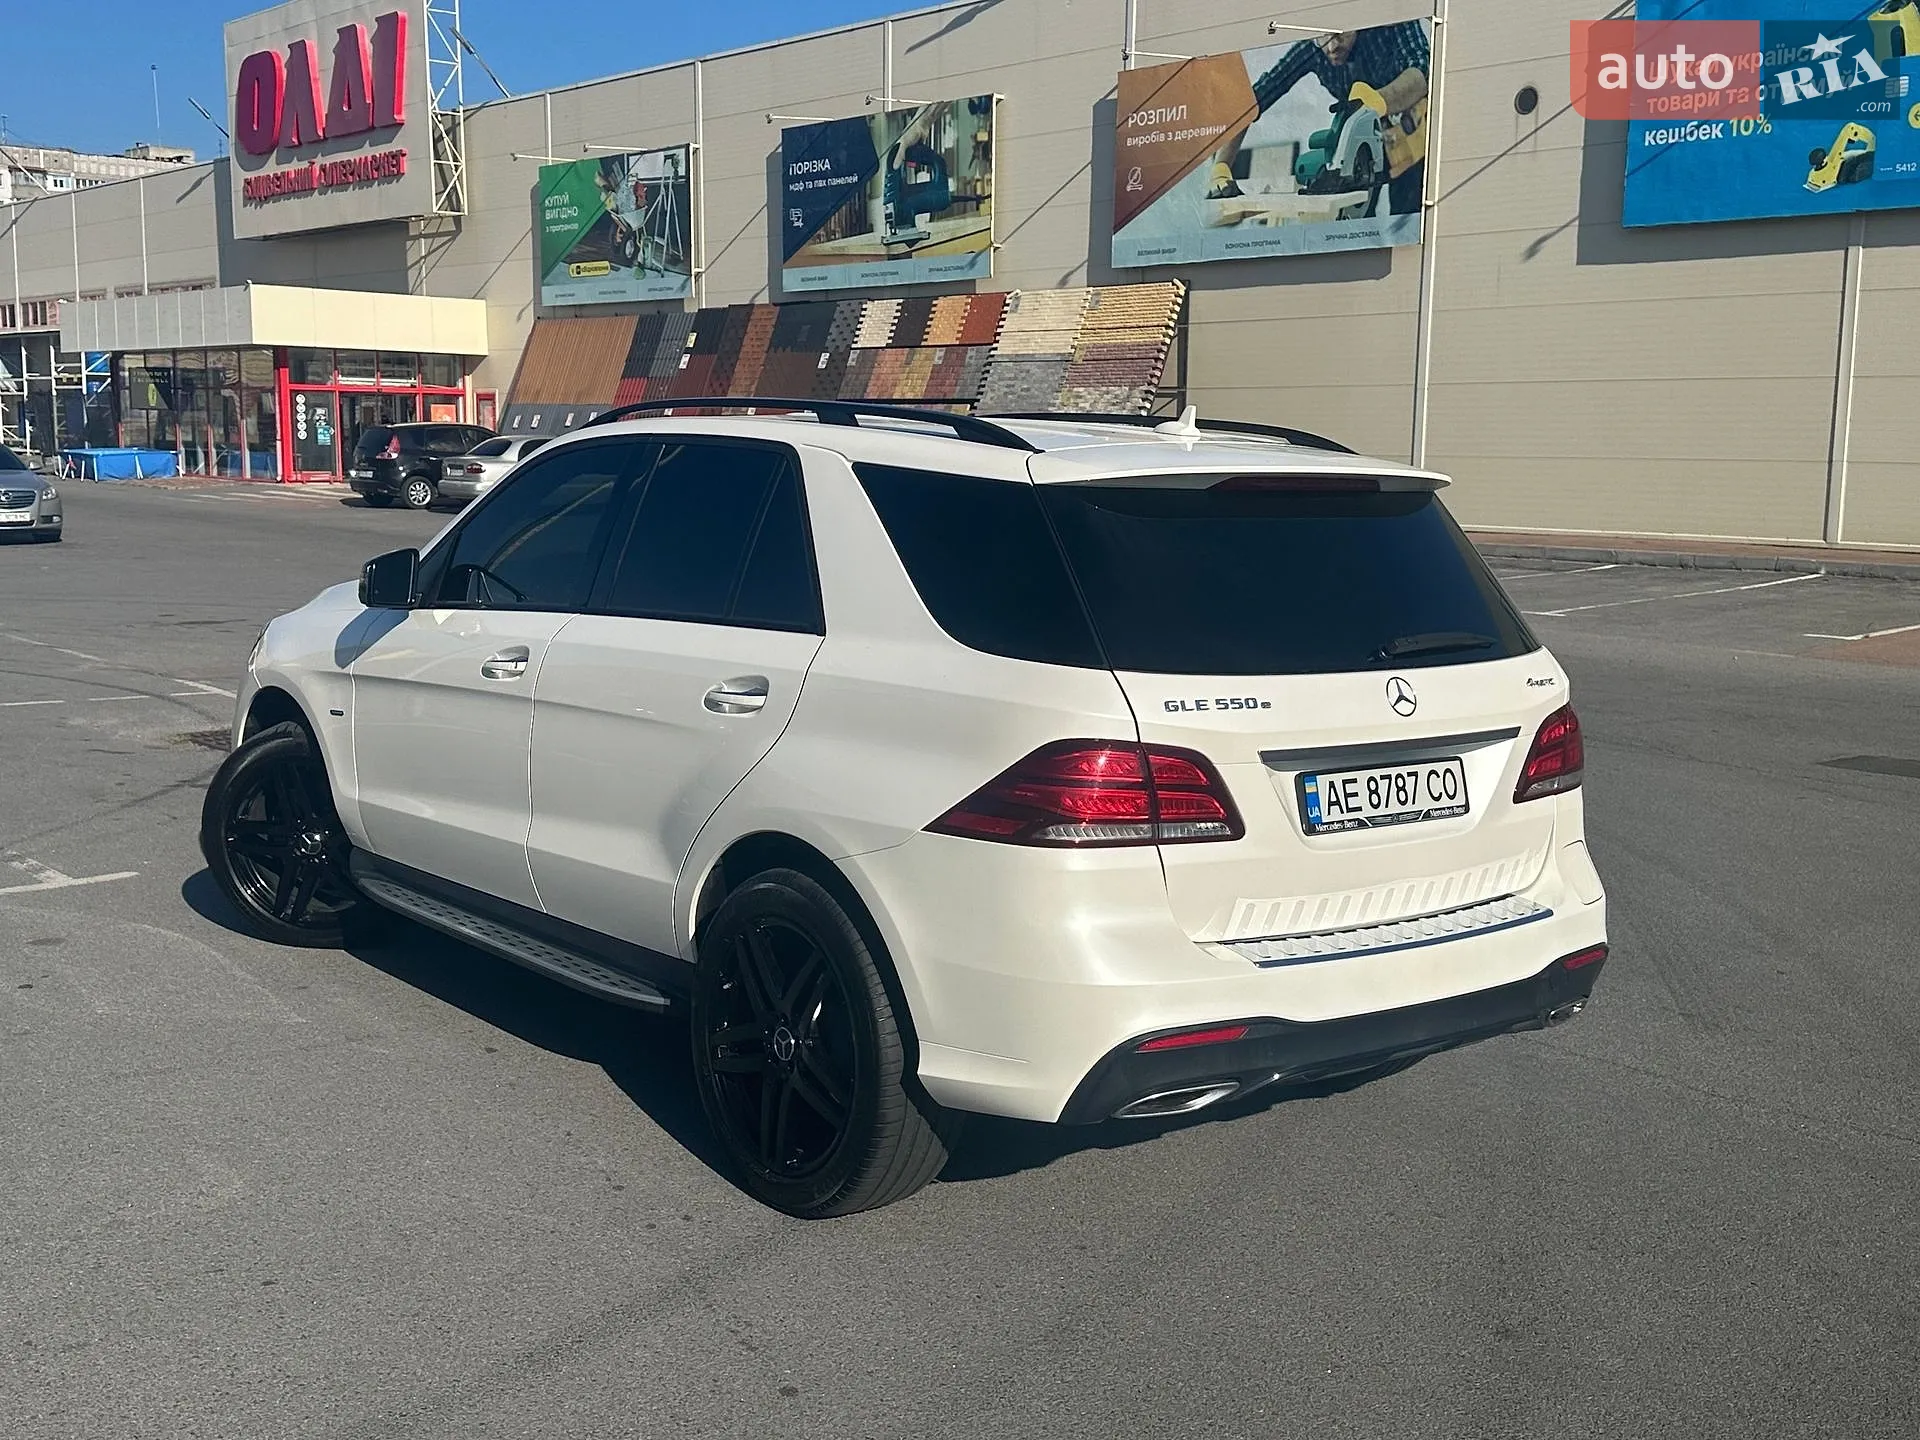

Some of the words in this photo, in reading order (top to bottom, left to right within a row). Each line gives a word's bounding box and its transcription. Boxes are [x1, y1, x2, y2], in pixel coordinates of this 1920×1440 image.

[236, 11, 408, 156] ОЛДІ
[1646, 89, 1721, 115] товари
[1725, 87, 1750, 105] та
[1127, 104, 1188, 128] РОЗПИЛ
[1126, 130, 1166, 148] виробів
[1166, 131, 1174, 141] з
[1174, 124, 1228, 143] деревини
[1643, 121, 1725, 147] кешбек
[1729, 112, 1773, 138] 10%
[789, 158, 832, 176] ПОРІЗКА
[1895, 162, 1918, 173] 5412
[827, 172, 859, 186] панелей
[544, 191, 570, 208] КУПУЙ
[1163, 699, 1210, 713] GLE
[1326, 777, 1363, 817] AE
[1366, 770, 1419, 810] 8787
[1426, 767, 1458, 802] CO
[1307, 806, 1321, 819] UA
[1429, 806, 1466, 818] Mercedes-Benz
[1314, 819, 1359, 833] Mercedes-Benz
